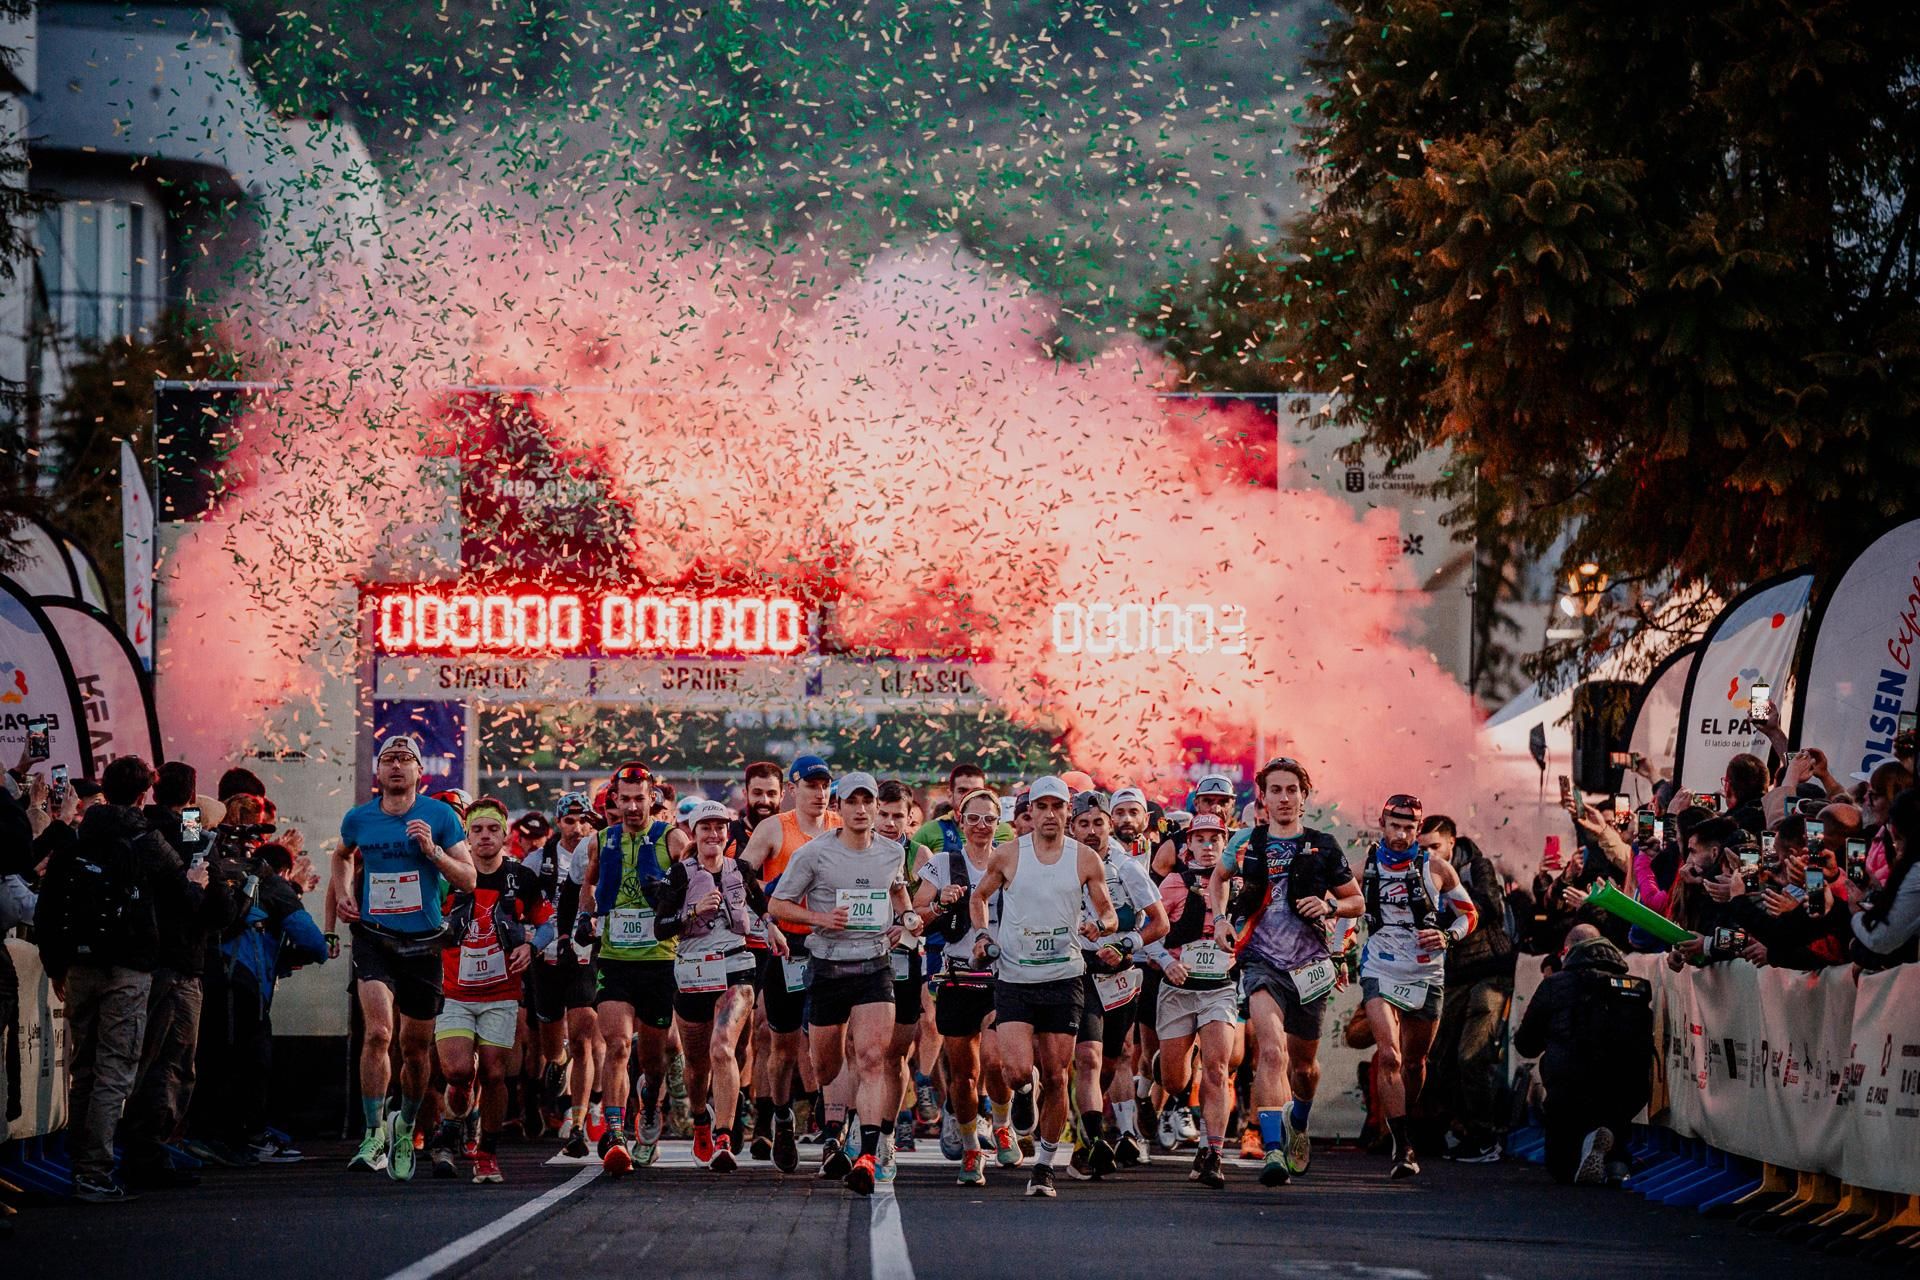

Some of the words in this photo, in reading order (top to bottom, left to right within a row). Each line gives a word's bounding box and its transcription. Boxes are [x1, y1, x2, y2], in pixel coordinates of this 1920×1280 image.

[1369, 472, 1415, 480] Goberno
[543, 480, 597, 498] OLEN
[662, 667, 739, 690] SPRINT
[881, 669, 972, 693] CLASSIC
[1701, 718, 1722, 735] EL
[1728, 718, 1757, 735] PA
[1704, 739, 1711, 747] El
[1712, 739, 1731, 747] latido
[1732, 740, 1741, 748] de
[389, 886, 396, 900] 2
[852, 903, 873, 917] 204
[623, 921, 642, 934] 206
[1035, 938, 1056, 952] 201
[1196, 952, 1215, 965] 202
[476, 960, 488, 972] 10
[695, 965, 703, 978] 1
[1307, 966, 1325, 985] 209
[1115, 976, 1128, 990] 13
[1393, 985, 1411, 999] 272
